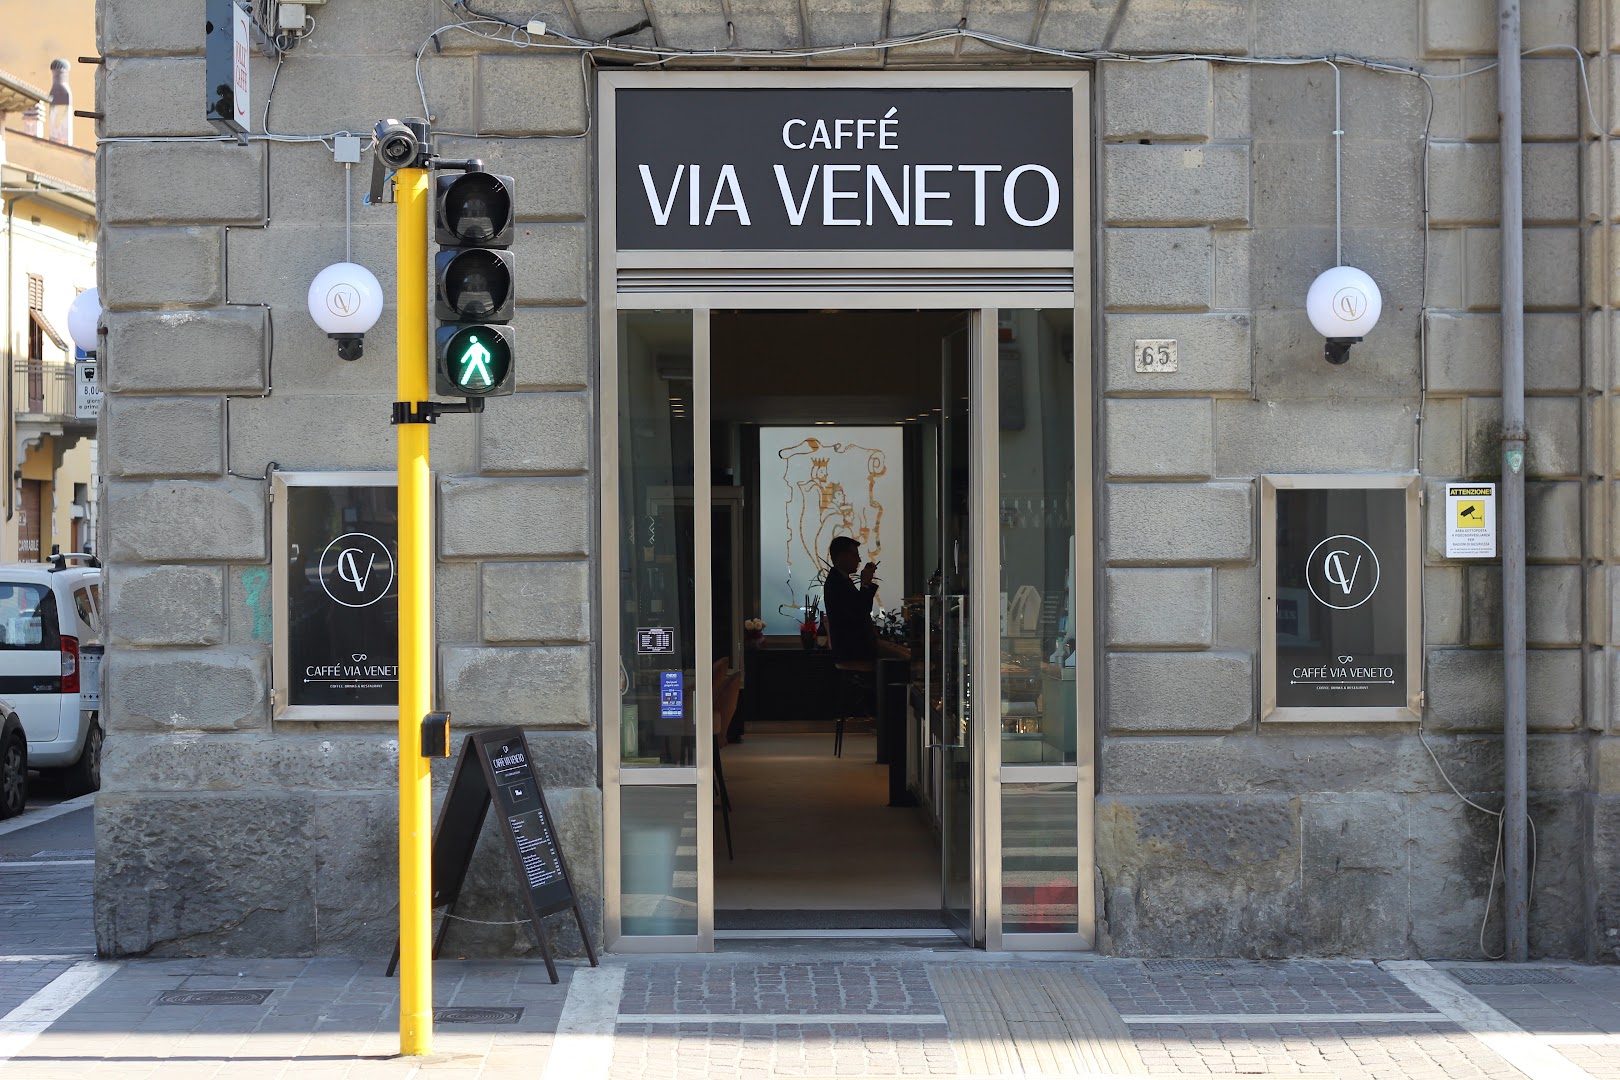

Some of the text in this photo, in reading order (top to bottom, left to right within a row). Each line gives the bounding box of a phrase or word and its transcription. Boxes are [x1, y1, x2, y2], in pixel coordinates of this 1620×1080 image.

[782, 106, 899, 150] CAFFÉ
[638, 163, 1060, 227] VIA VENETO
[1142, 345, 1170, 366] 65
[306, 662, 399, 677] CAFFÉ VIA VENET
[1292, 664, 1393, 678] CAFFÉ VIA VENETO
